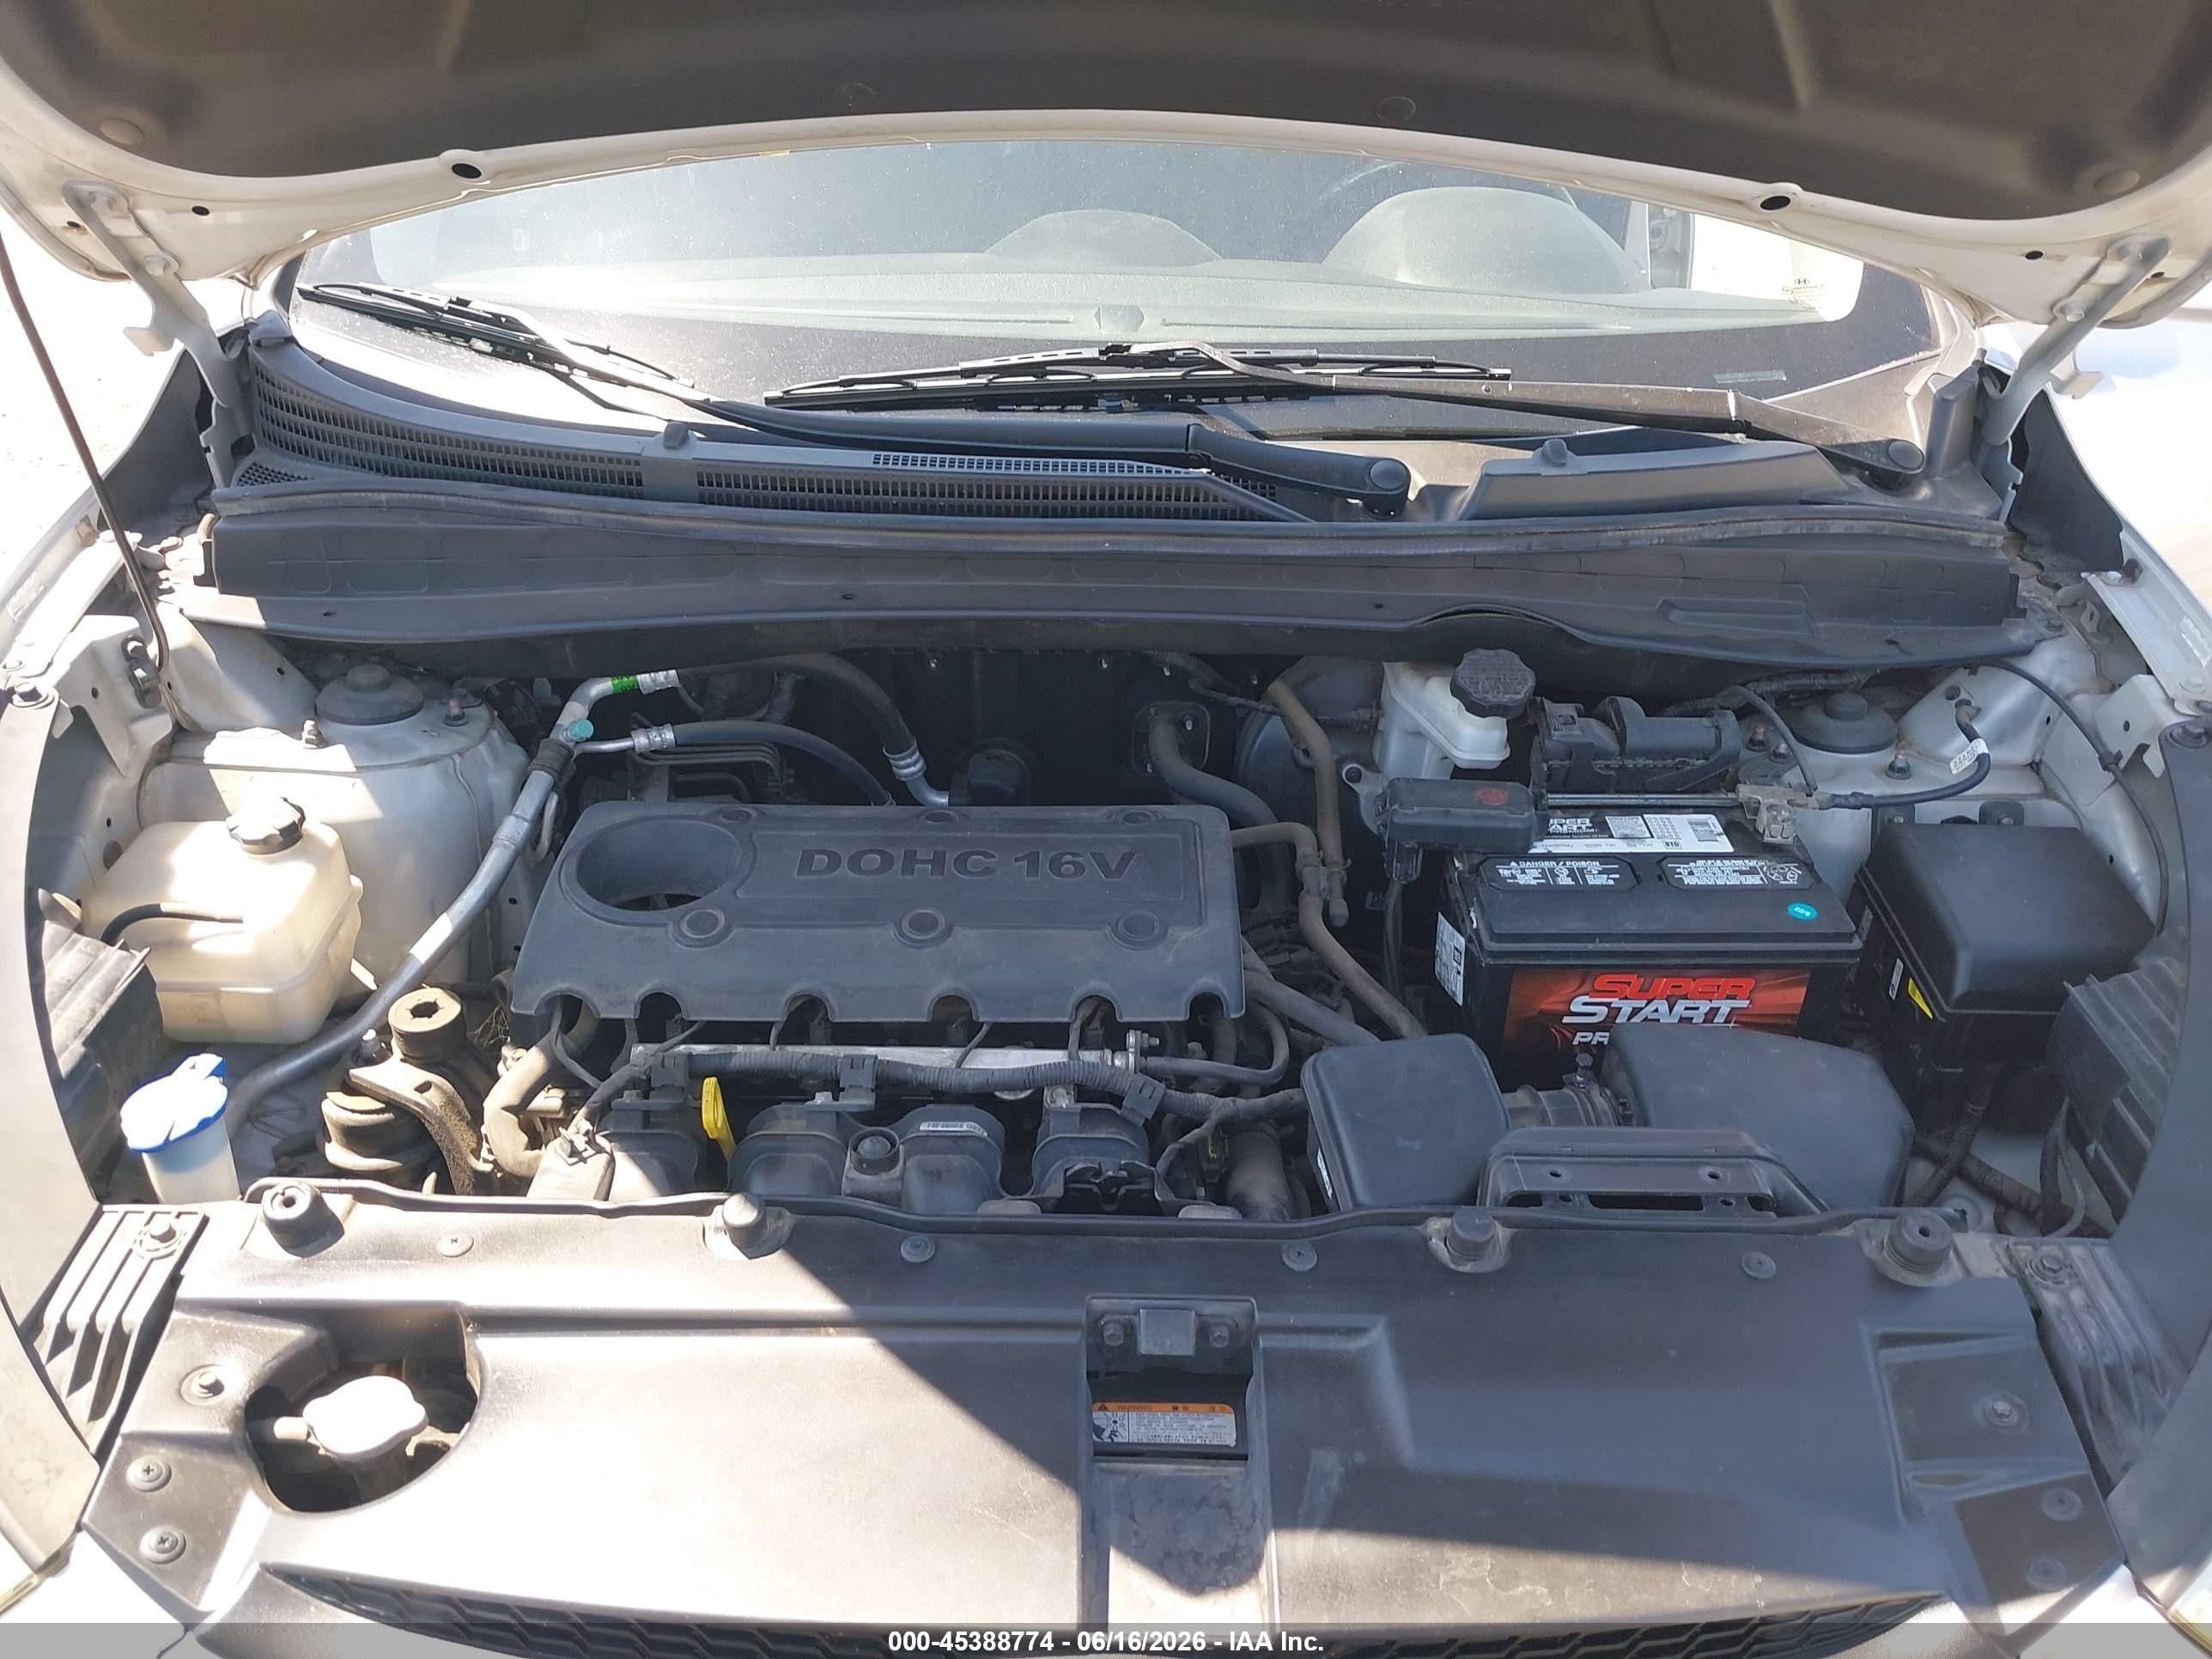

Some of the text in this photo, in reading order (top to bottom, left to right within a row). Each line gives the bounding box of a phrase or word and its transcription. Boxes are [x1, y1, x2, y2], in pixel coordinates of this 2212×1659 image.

[794, 848, 1138, 880] DOHC 16V
[1589, 974, 1756, 1000] SUPER
[1561, 995, 1752, 1024] START
[1571, 1031, 1610, 1046] PR
